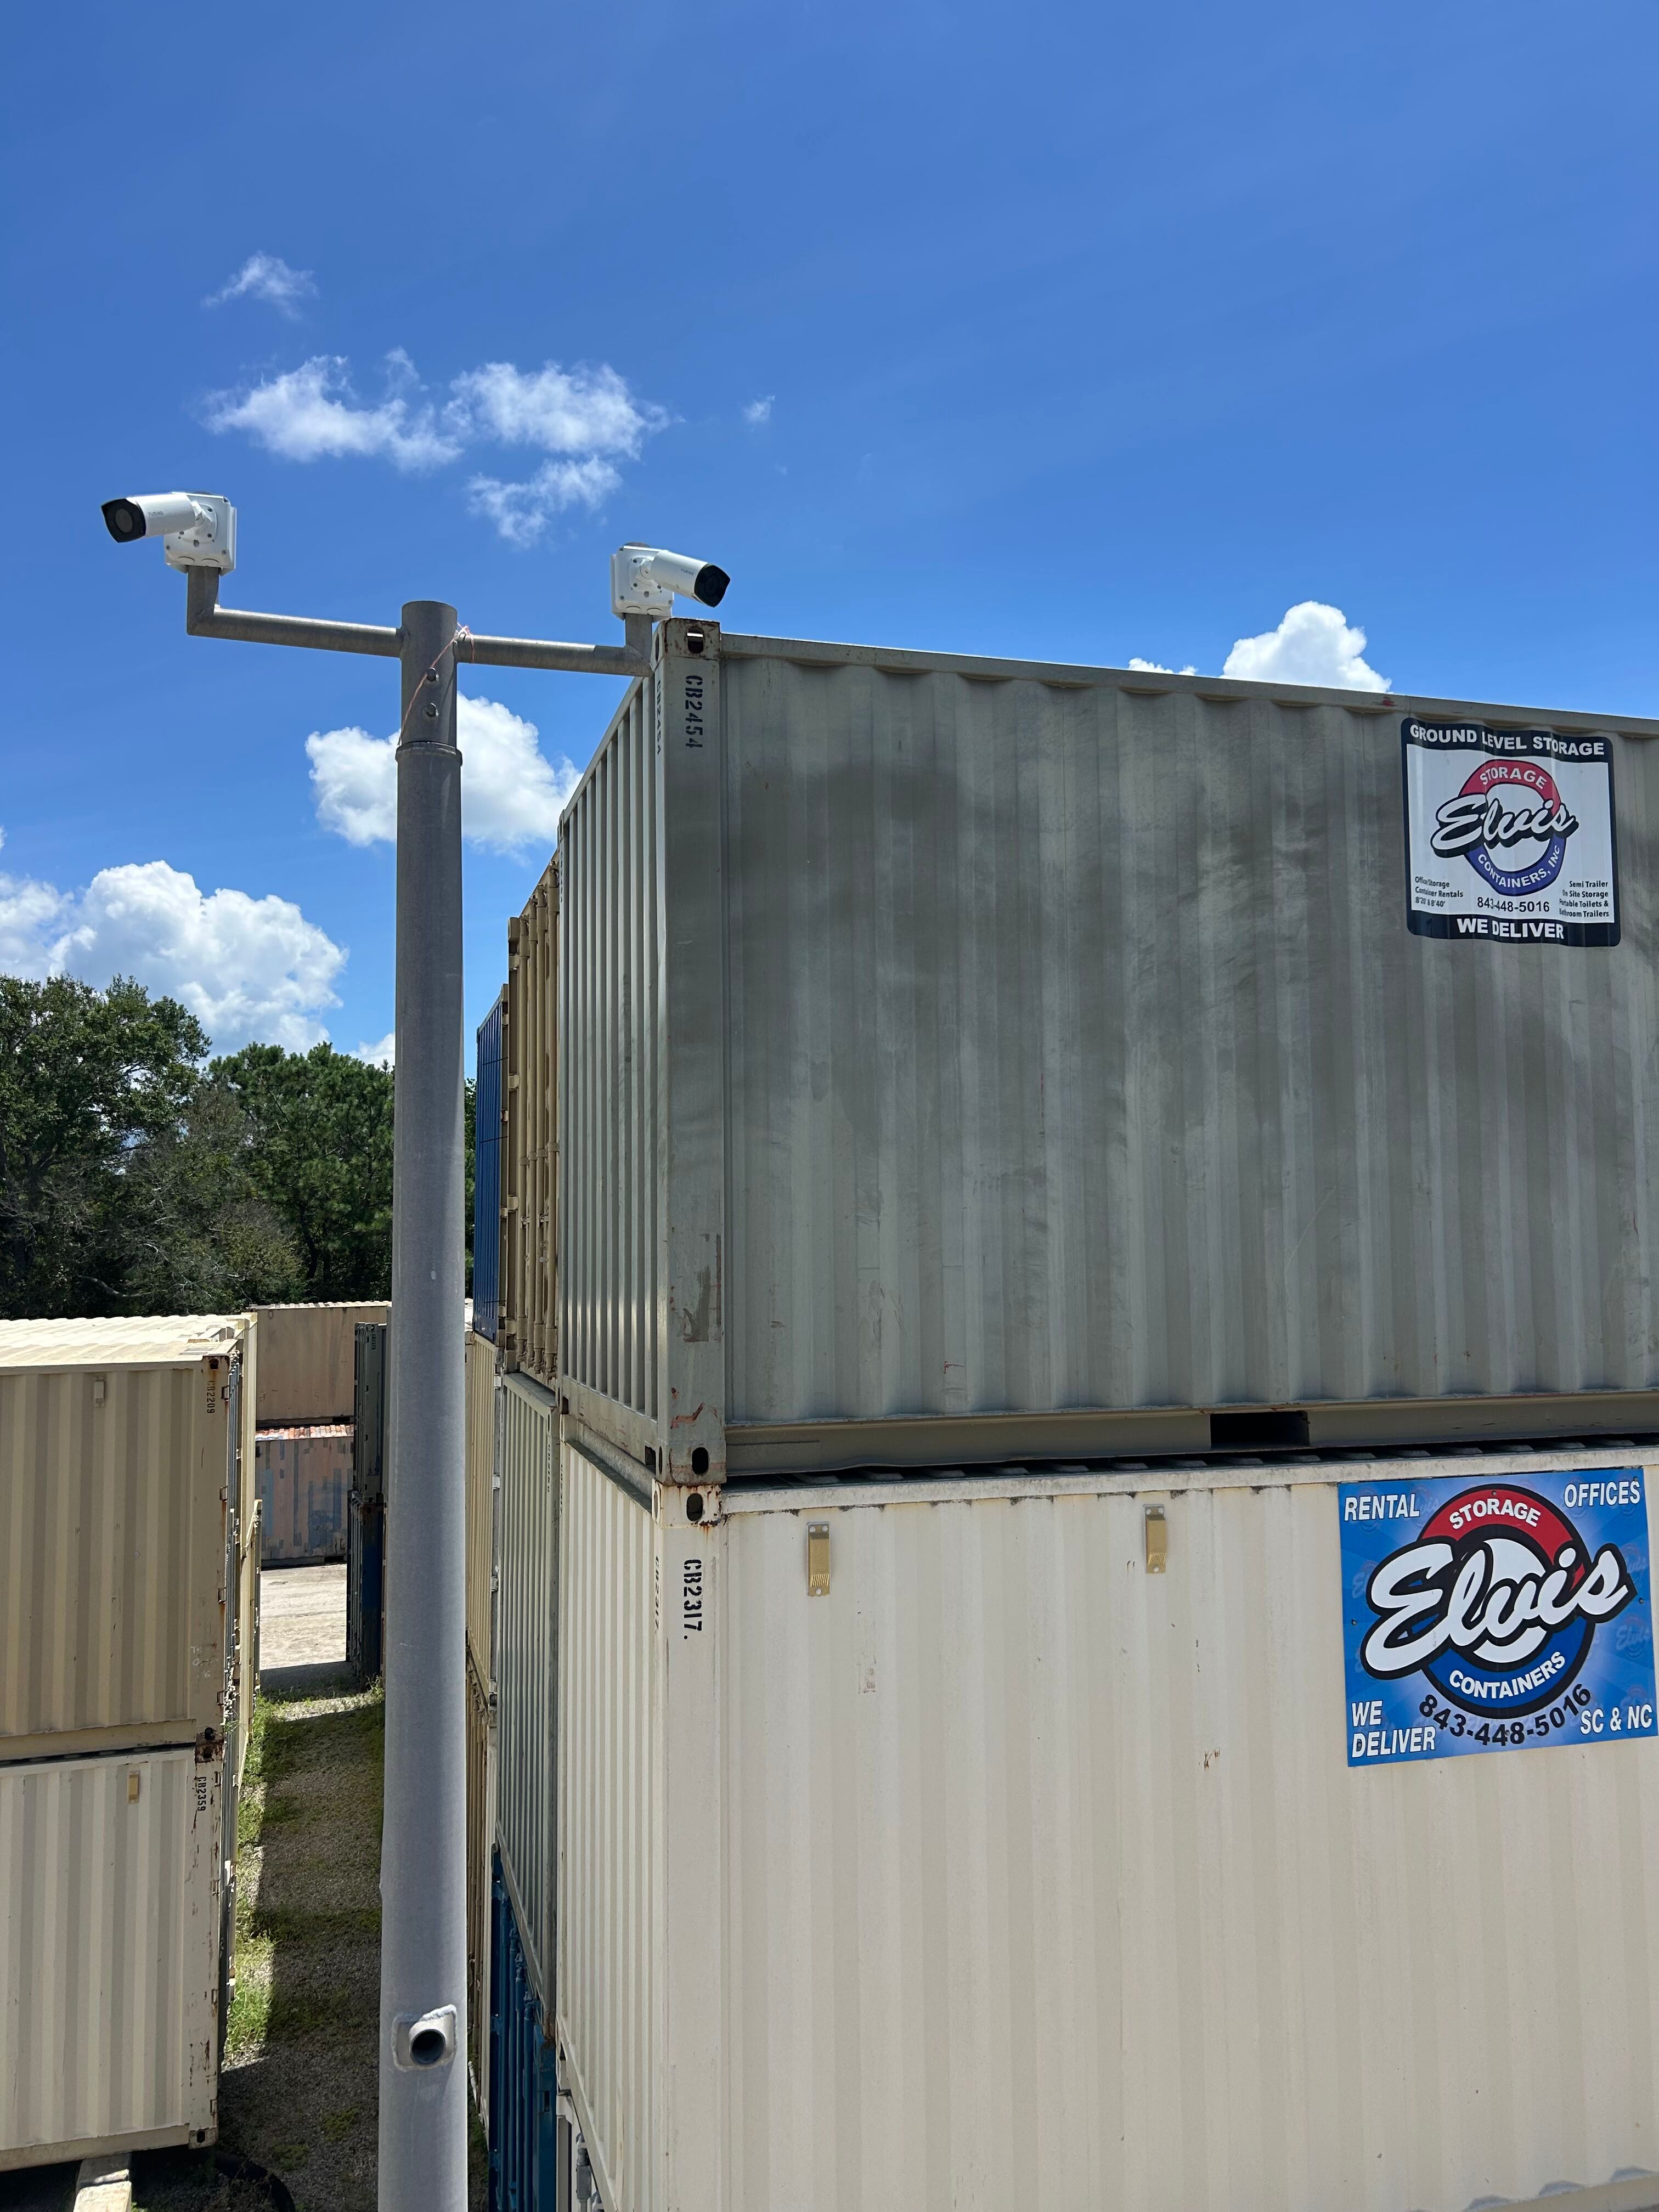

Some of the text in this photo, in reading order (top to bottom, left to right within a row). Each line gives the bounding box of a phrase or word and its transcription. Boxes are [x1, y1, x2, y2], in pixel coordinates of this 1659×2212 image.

[685, 675, 703, 748] CB2454
[1410, 724, 1604, 755] GROUND LEVEL STORAGE
[1480, 767, 1547, 789] STORAGE
[1430, 794, 1578, 856] Elvis
[1477, 845, 1561, 888] CONTAINERS, INC
[1477, 896, 1550, 912] 843-448-5016
[1582, 891, 1609, 899] Storage
[1457, 918, 1564, 939] WE DELIVER
[207, 1380, 216, 1414] CB2209
[1344, 1494, 1420, 1521] RENTAL
[1564, 1480, 1641, 1508] OFFICES
[1449, 1498, 1541, 1530] STORAGE
[1363, 1541, 1632, 1674] Elvis
[1449, 1651, 1566, 1699] CONTAINERS
[1352, 1700, 1383, 1727] WE
[1419, 1684, 1592, 1746] 843-448-5016
[1580, 1704, 1652, 1735] SC & NC
[1352, 1726, 1436, 1758] DELIVER
[196, 1776, 207, 1812] CB2359
